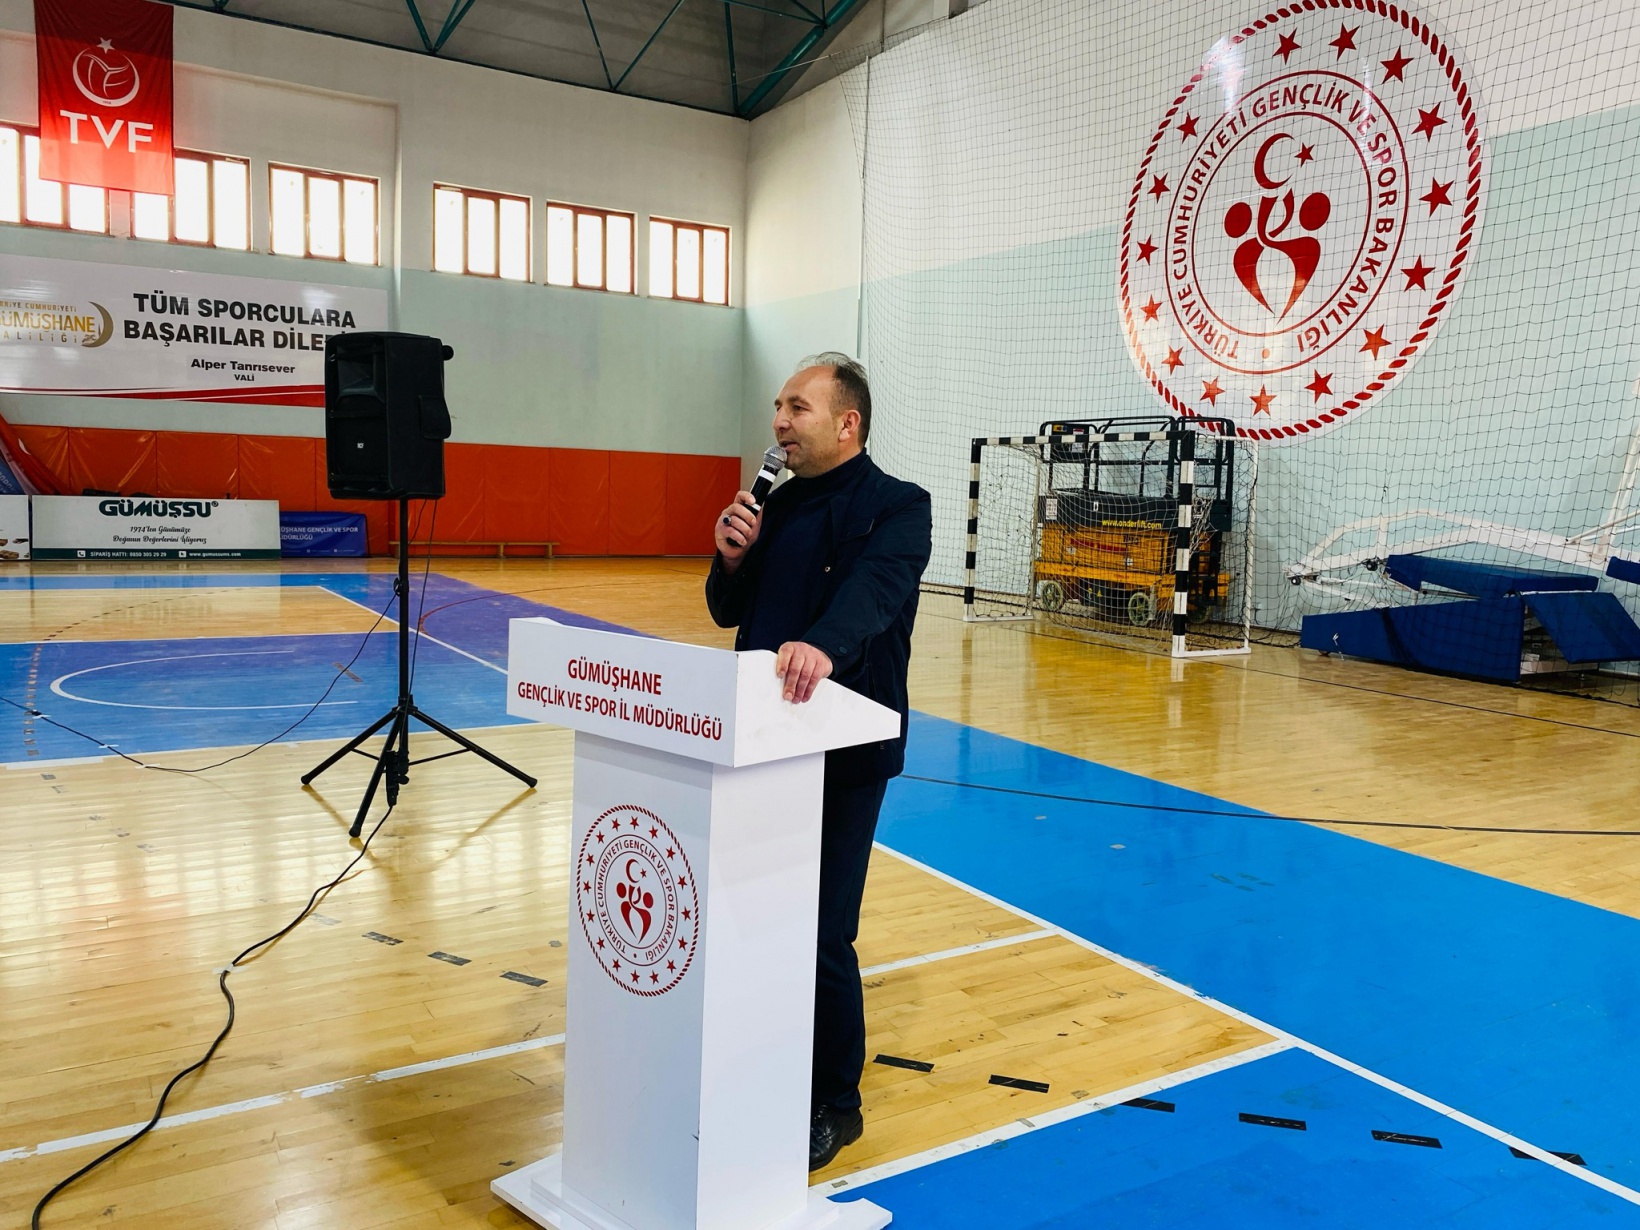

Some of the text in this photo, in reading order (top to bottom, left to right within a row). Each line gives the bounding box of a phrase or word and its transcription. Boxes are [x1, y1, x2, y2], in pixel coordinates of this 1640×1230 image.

[60, 109, 154, 153] TVF
[1173, 81, 1398, 360] TÜRKİYE CUMHURİYETİ GENÇLİK VE SPOR BAKANLIĞI
[0, 310, 96, 333] ÜMÜŞHANE
[133, 289, 356, 328] TÜM SPORCULARA
[3, 331, 77, 343] ALİLİĞİ
[124, 319, 334, 352] BAŞARILAR DİLE
[190, 358, 296, 374] Alper Tanrısever
[234, 373, 255, 382] VALİ
[567, 656, 662, 695] GÜMÜŞHANE
[517, 681, 722, 741] GENÇLİK VE SPOR İL MÜDÜRLÜĞÜ
[597, 839, 623, 908] CUMHURİYETİ
[656, 860, 667, 877] VE
[663, 877, 675, 911] SPOR
[645, 914, 675, 961] BAKANLIĞI
